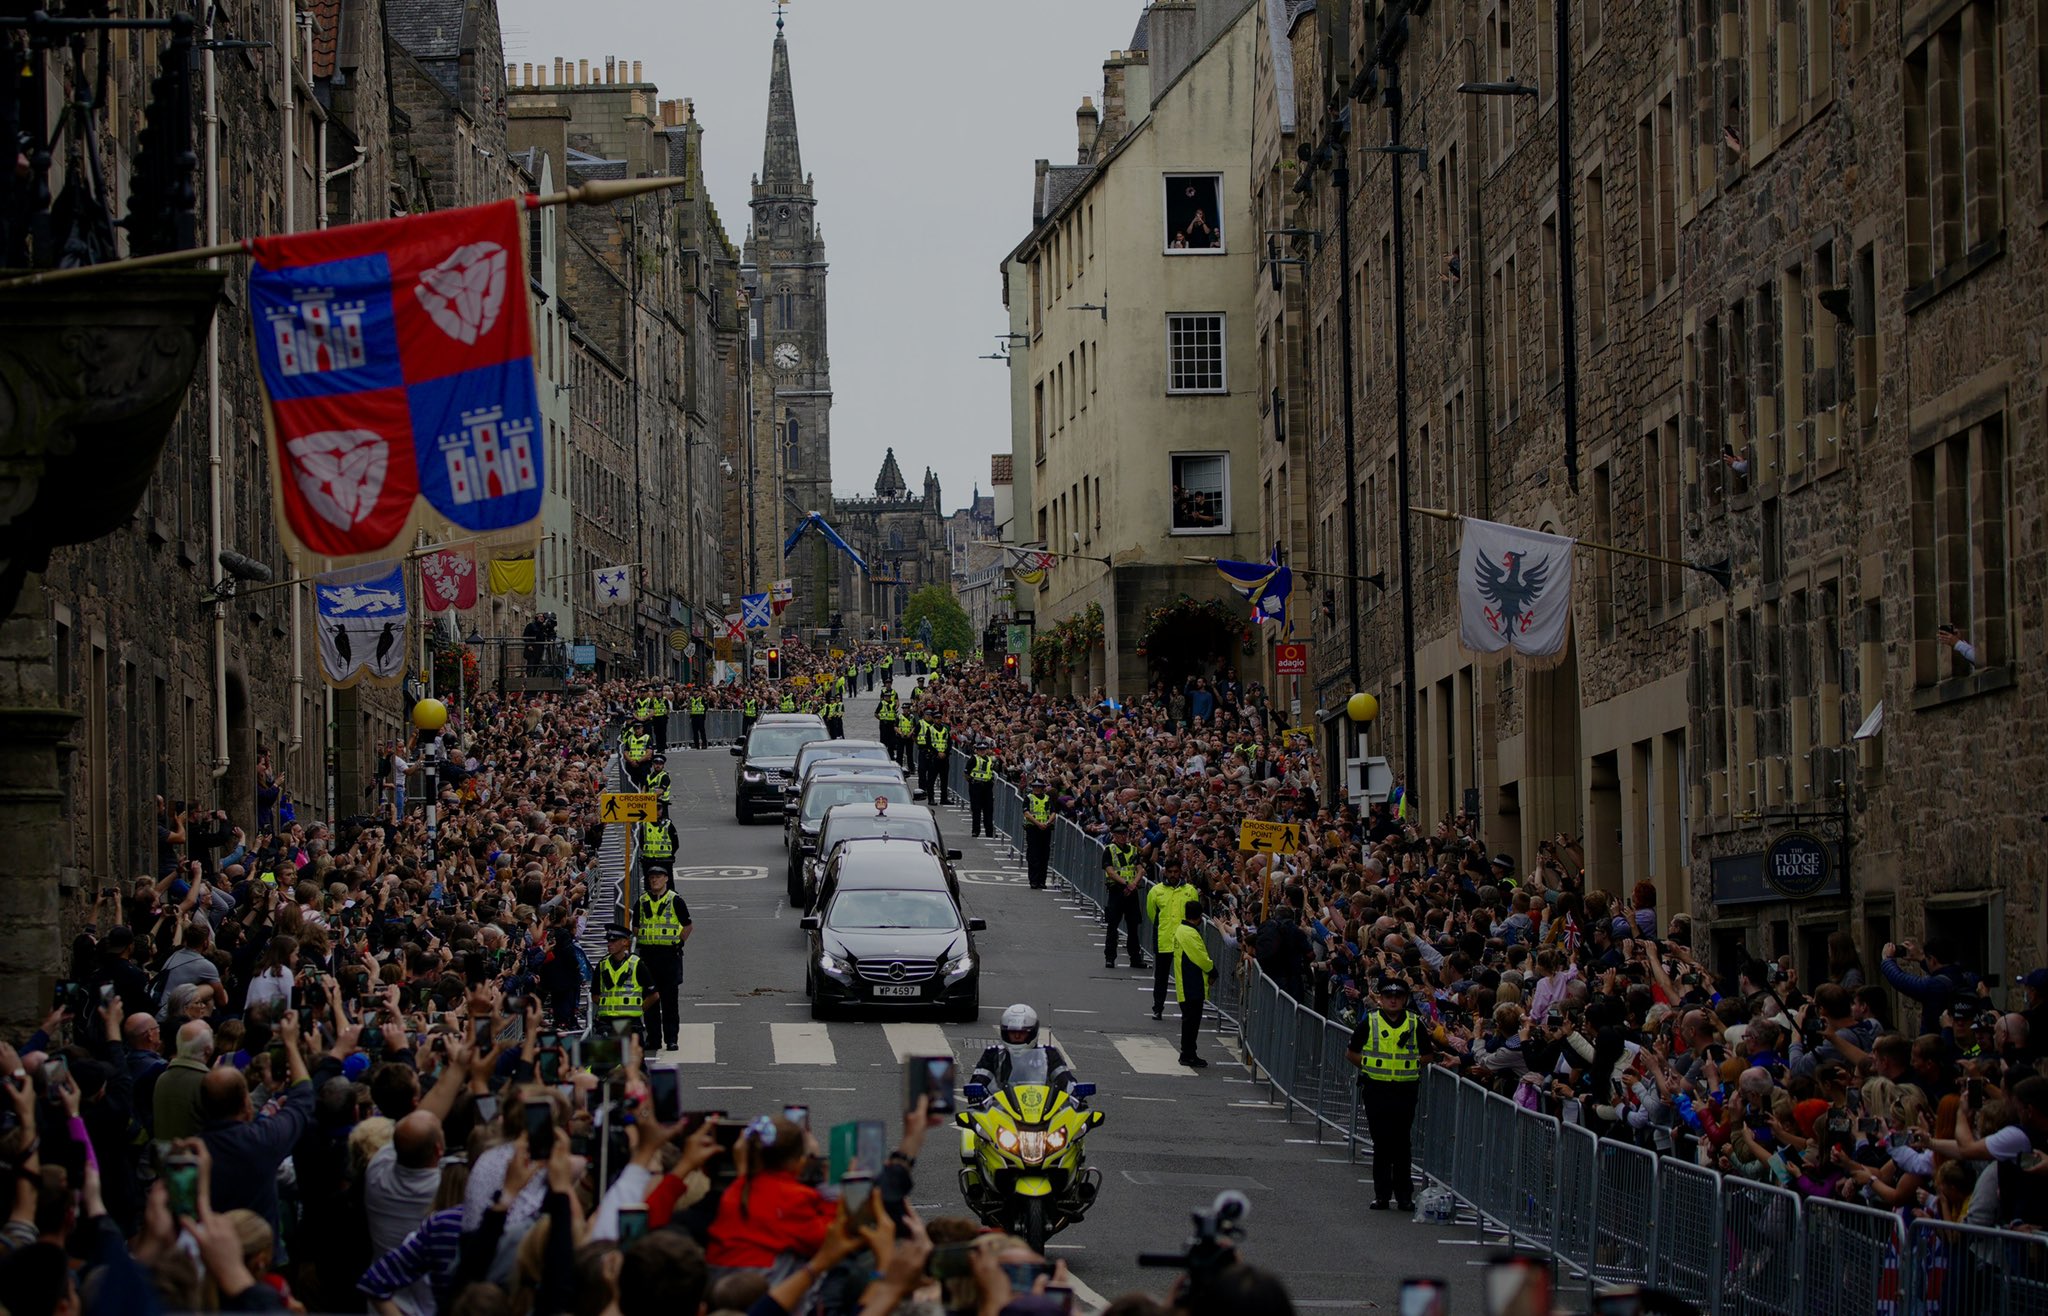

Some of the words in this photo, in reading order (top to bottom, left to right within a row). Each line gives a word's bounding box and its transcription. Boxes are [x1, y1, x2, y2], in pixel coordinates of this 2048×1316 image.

[1278, 658, 1305, 668] adagio
[1243, 821, 1282, 831] CROSSING
[1251, 830, 1272, 838] POINT
[1775, 852, 1820, 866] FUDGE
[1776, 864, 1820, 876] HOUSE
[892, 986, 915, 995] 4597
